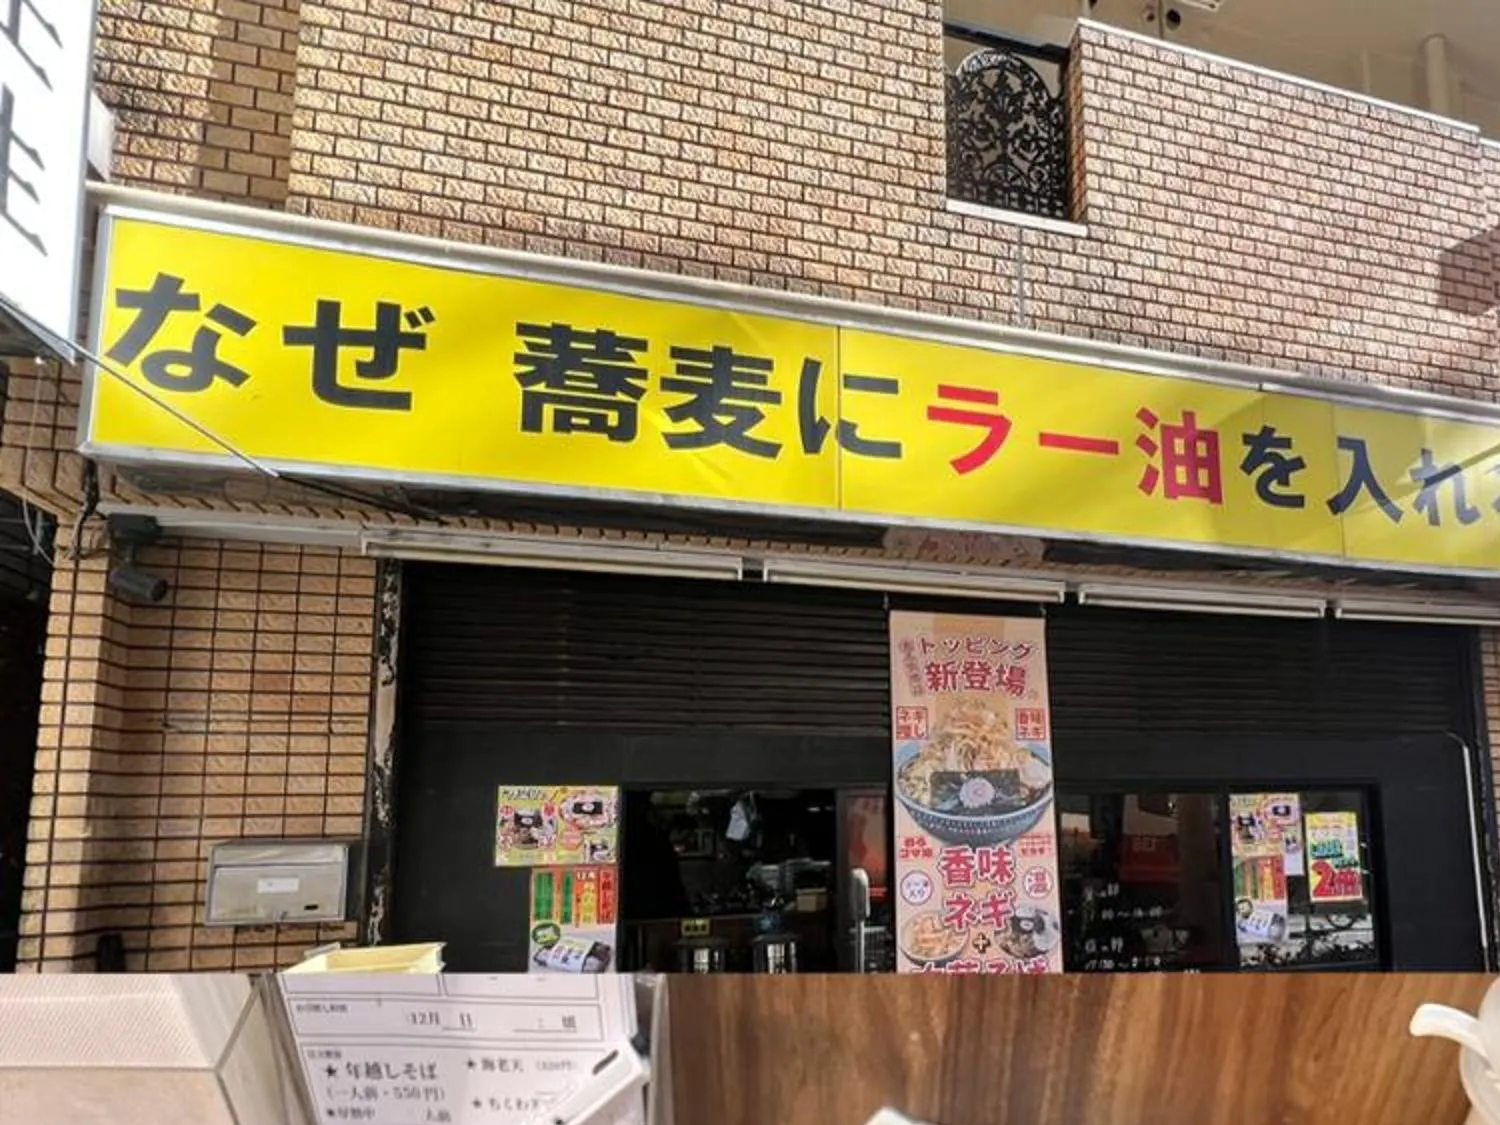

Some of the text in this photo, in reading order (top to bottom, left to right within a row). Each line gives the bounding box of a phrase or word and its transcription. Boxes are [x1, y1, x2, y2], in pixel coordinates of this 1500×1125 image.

[105, 271, 435, 412] なぜ
[926, 661, 1026, 696] 新登場
[940, 847, 1014, 886] 香味
[943, 891, 1015, 930] ネギ
